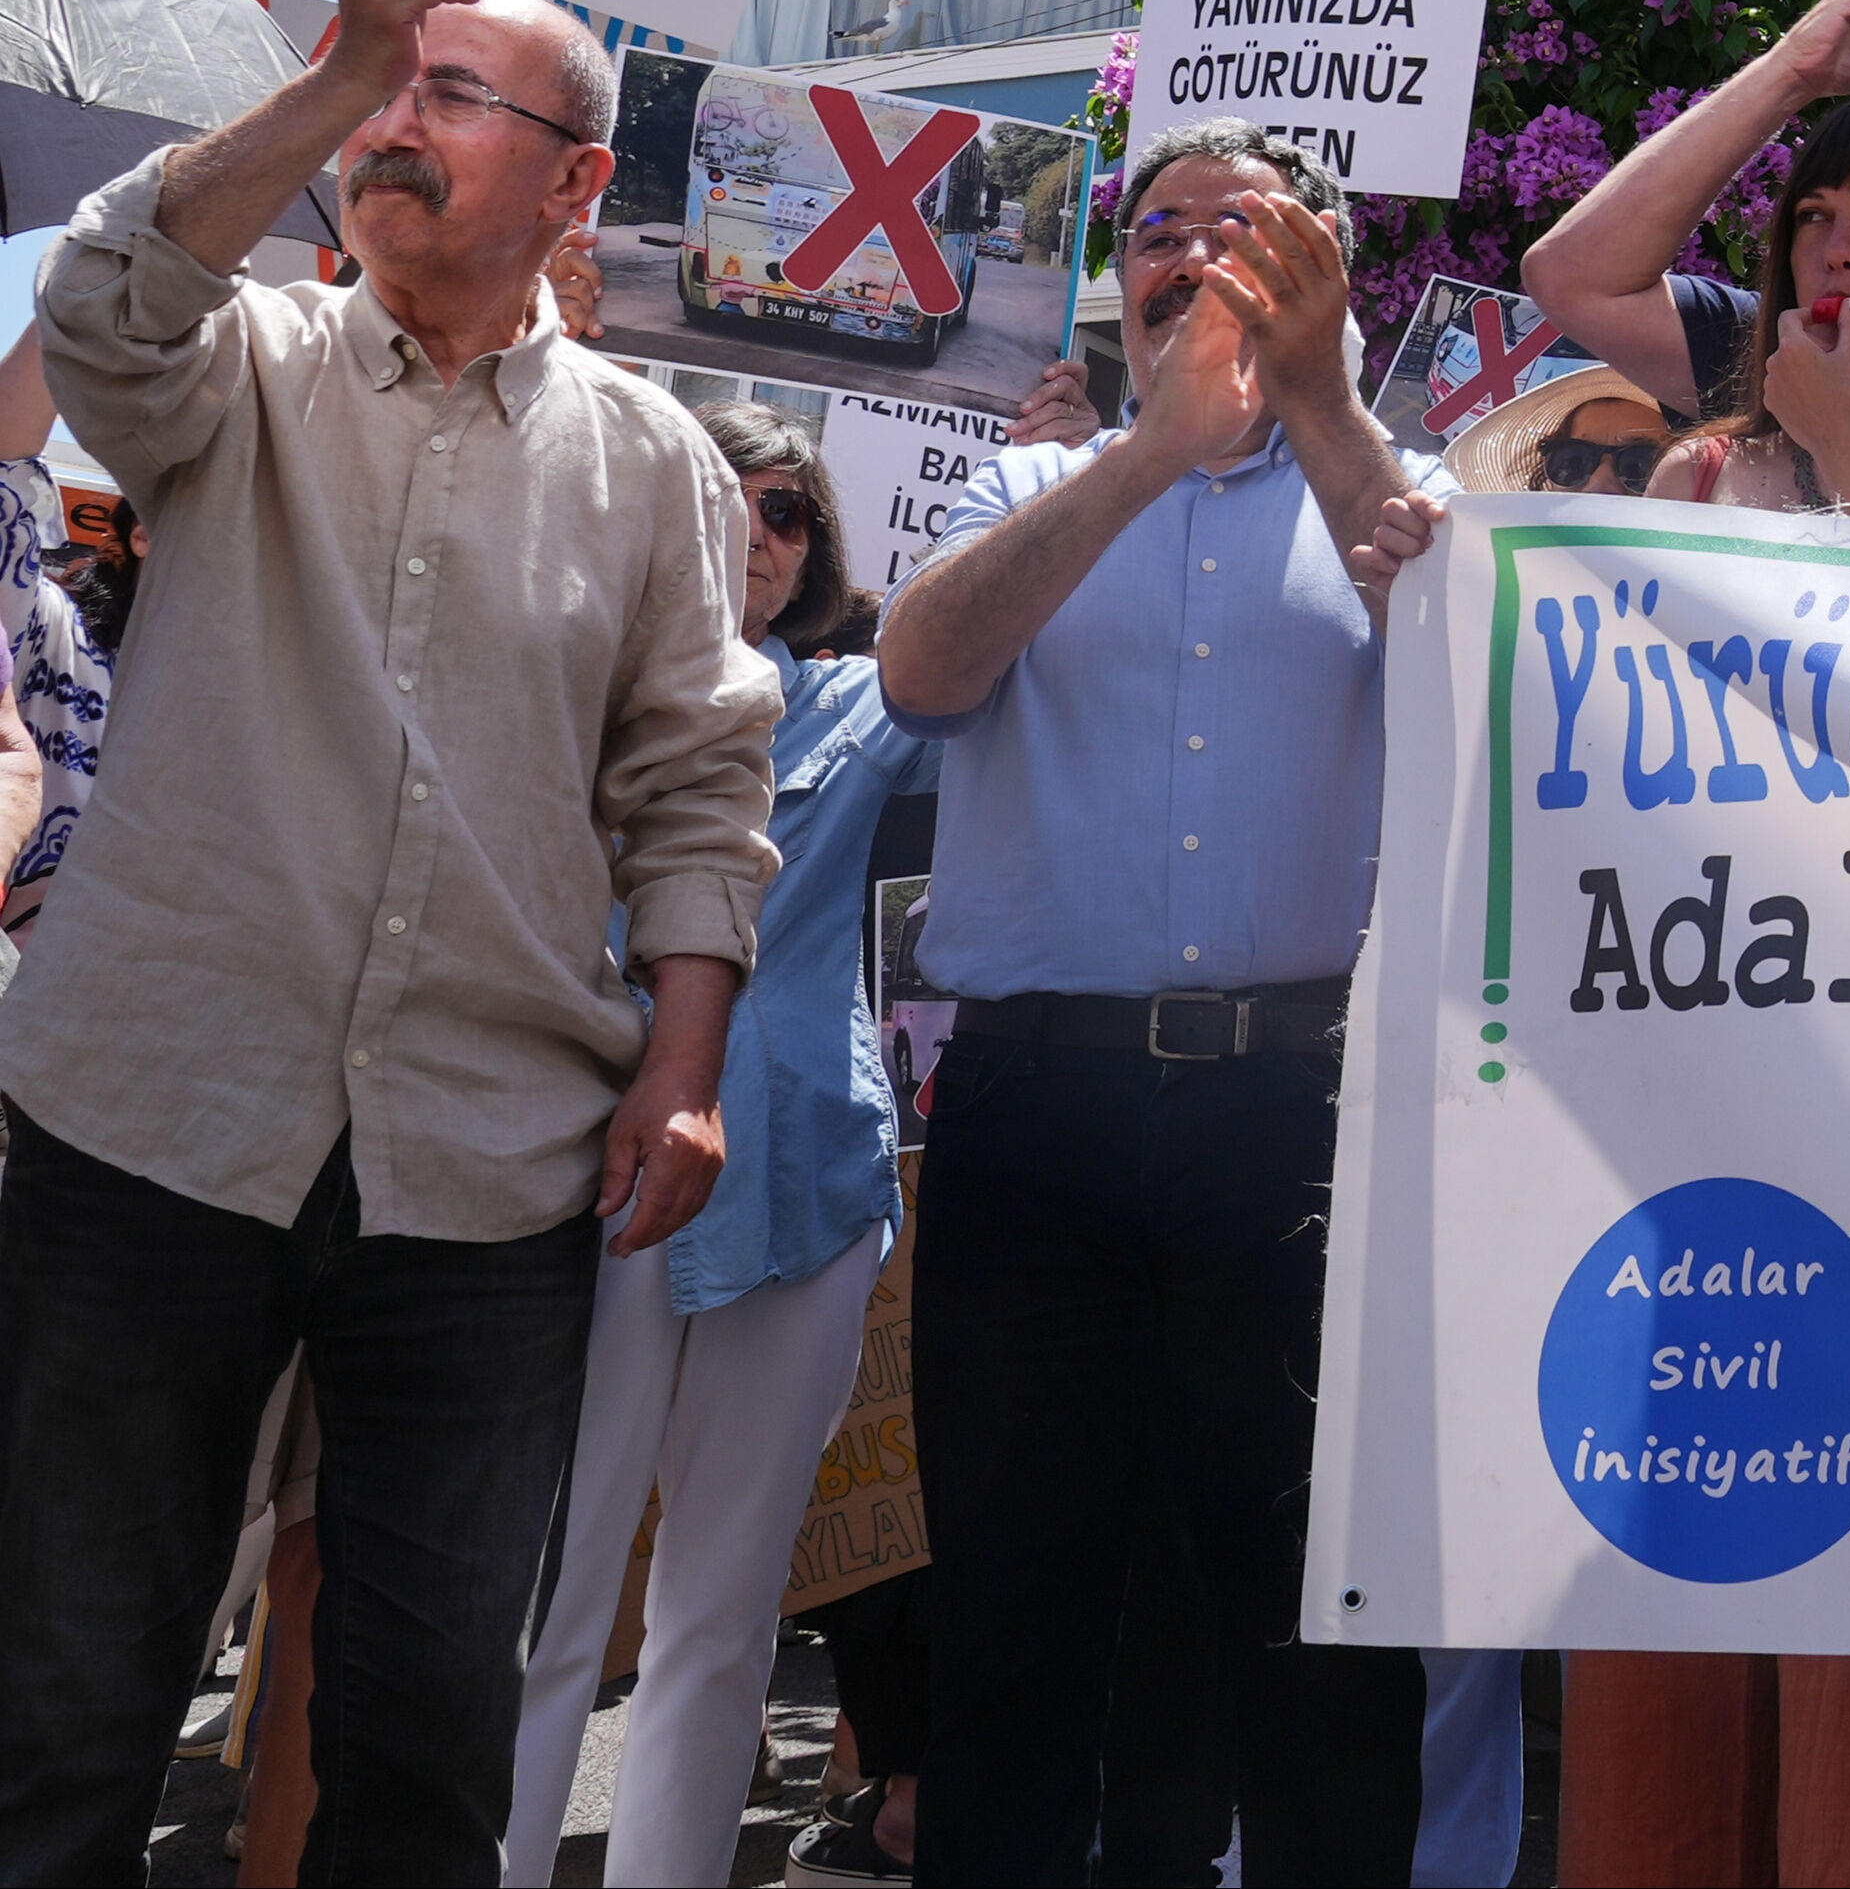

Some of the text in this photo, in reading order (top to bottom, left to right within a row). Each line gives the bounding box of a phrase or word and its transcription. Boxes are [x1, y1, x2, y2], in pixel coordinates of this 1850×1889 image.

[1169, 39, 1428, 105] GÖTÜRÜNÜZ
[765, 302, 780, 316] 34
[808, 310, 829, 324] 507
[1605, 1246, 1825, 1299] Adalar
[1649, 1339, 1782, 1391] Sivil
